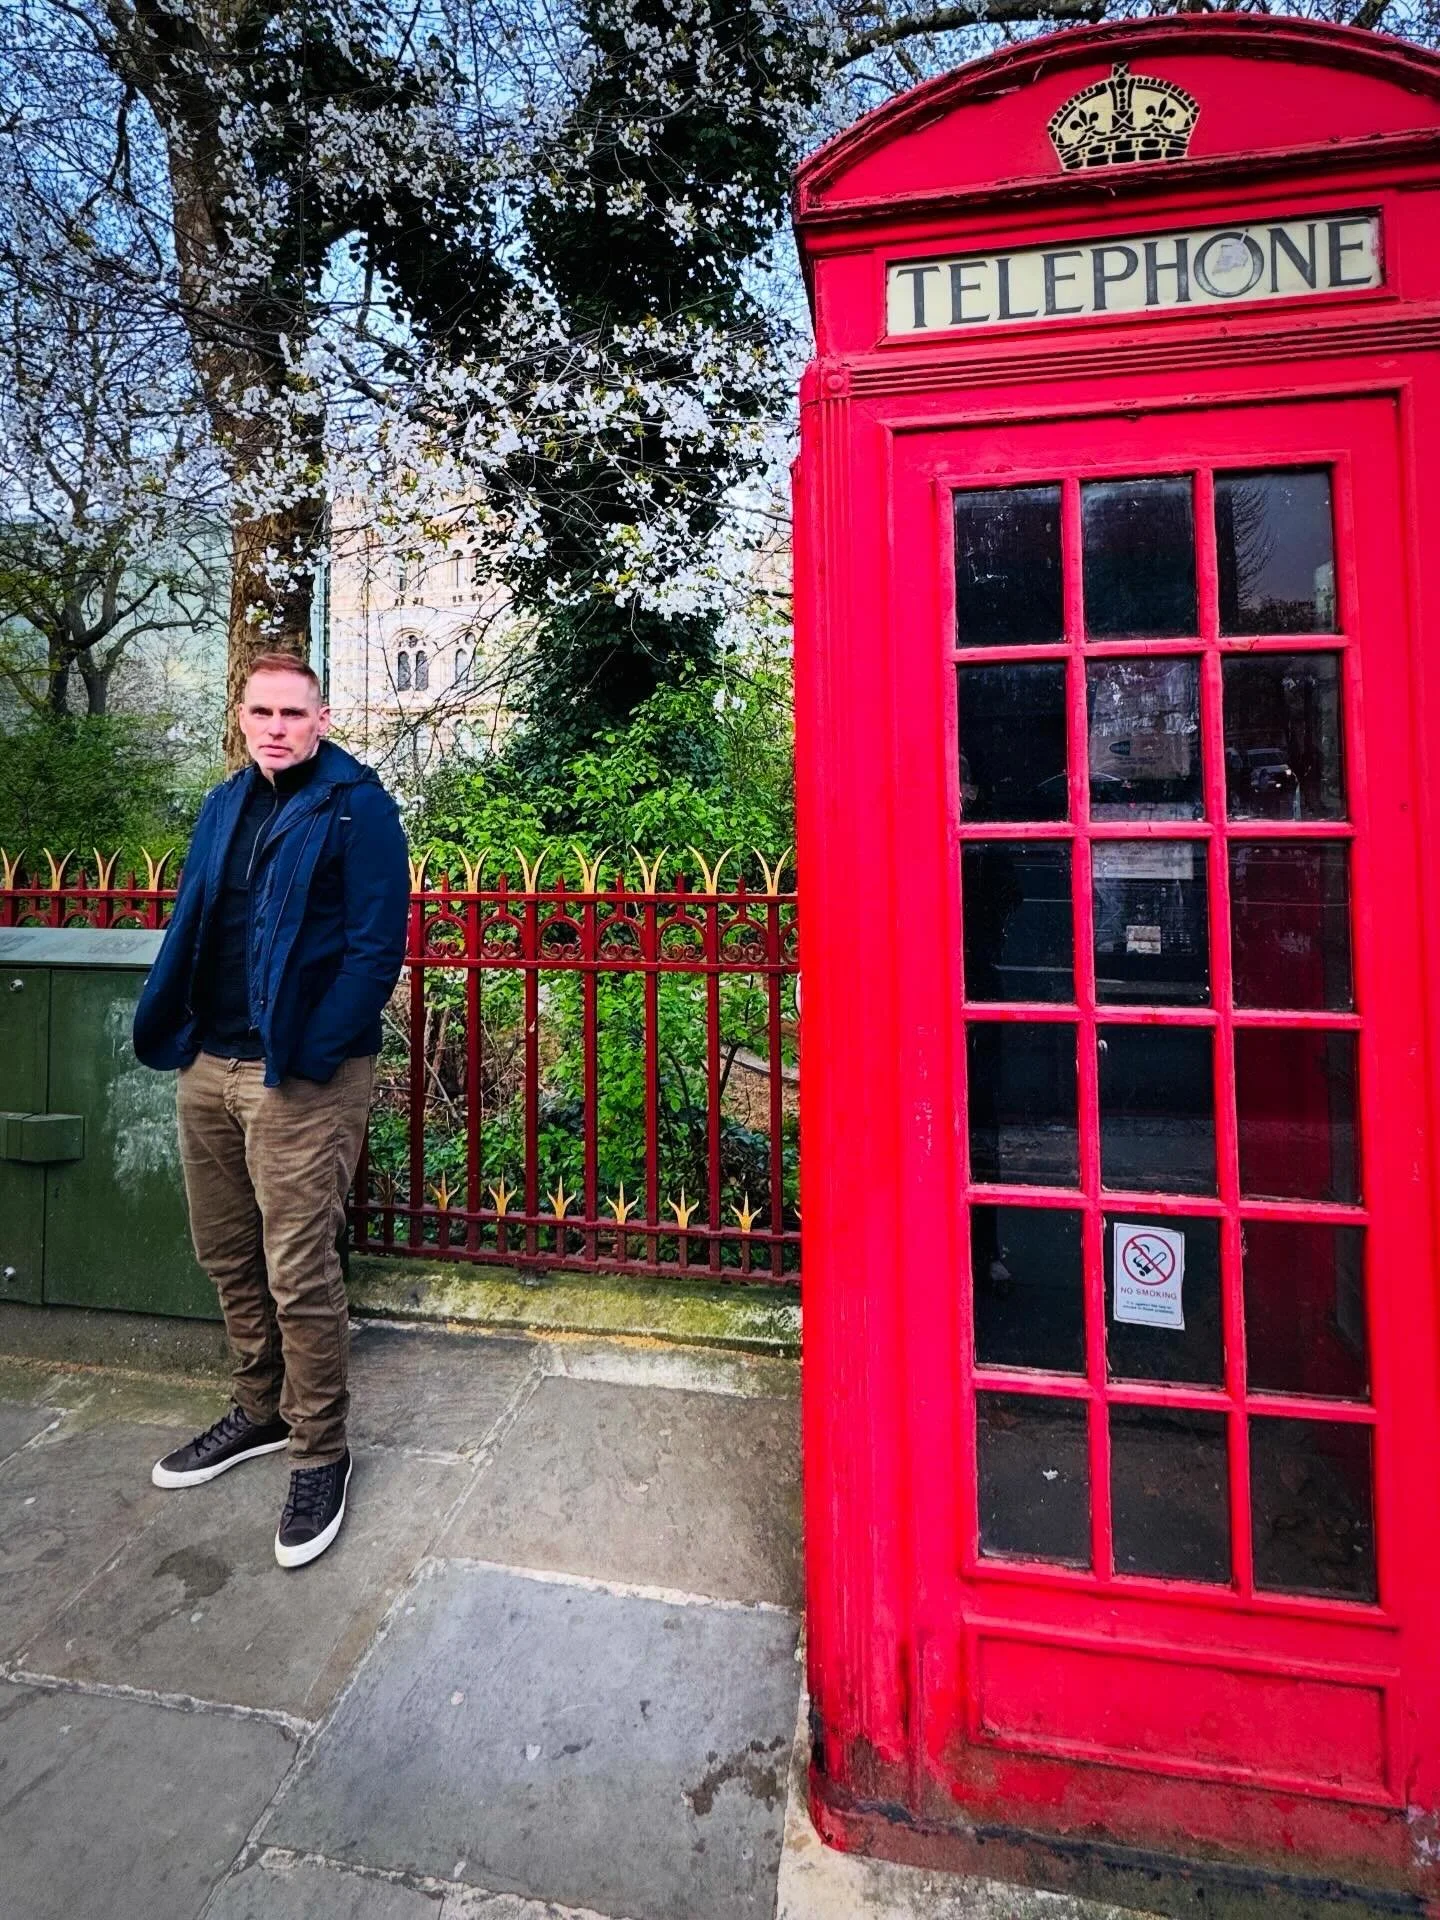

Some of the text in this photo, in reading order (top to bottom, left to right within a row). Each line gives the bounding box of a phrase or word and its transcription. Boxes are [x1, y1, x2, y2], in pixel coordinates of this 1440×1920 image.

[896, 218, 1371, 328] TELEPHONE
[1120, 1287, 1177, 1300] NO SMOKING
